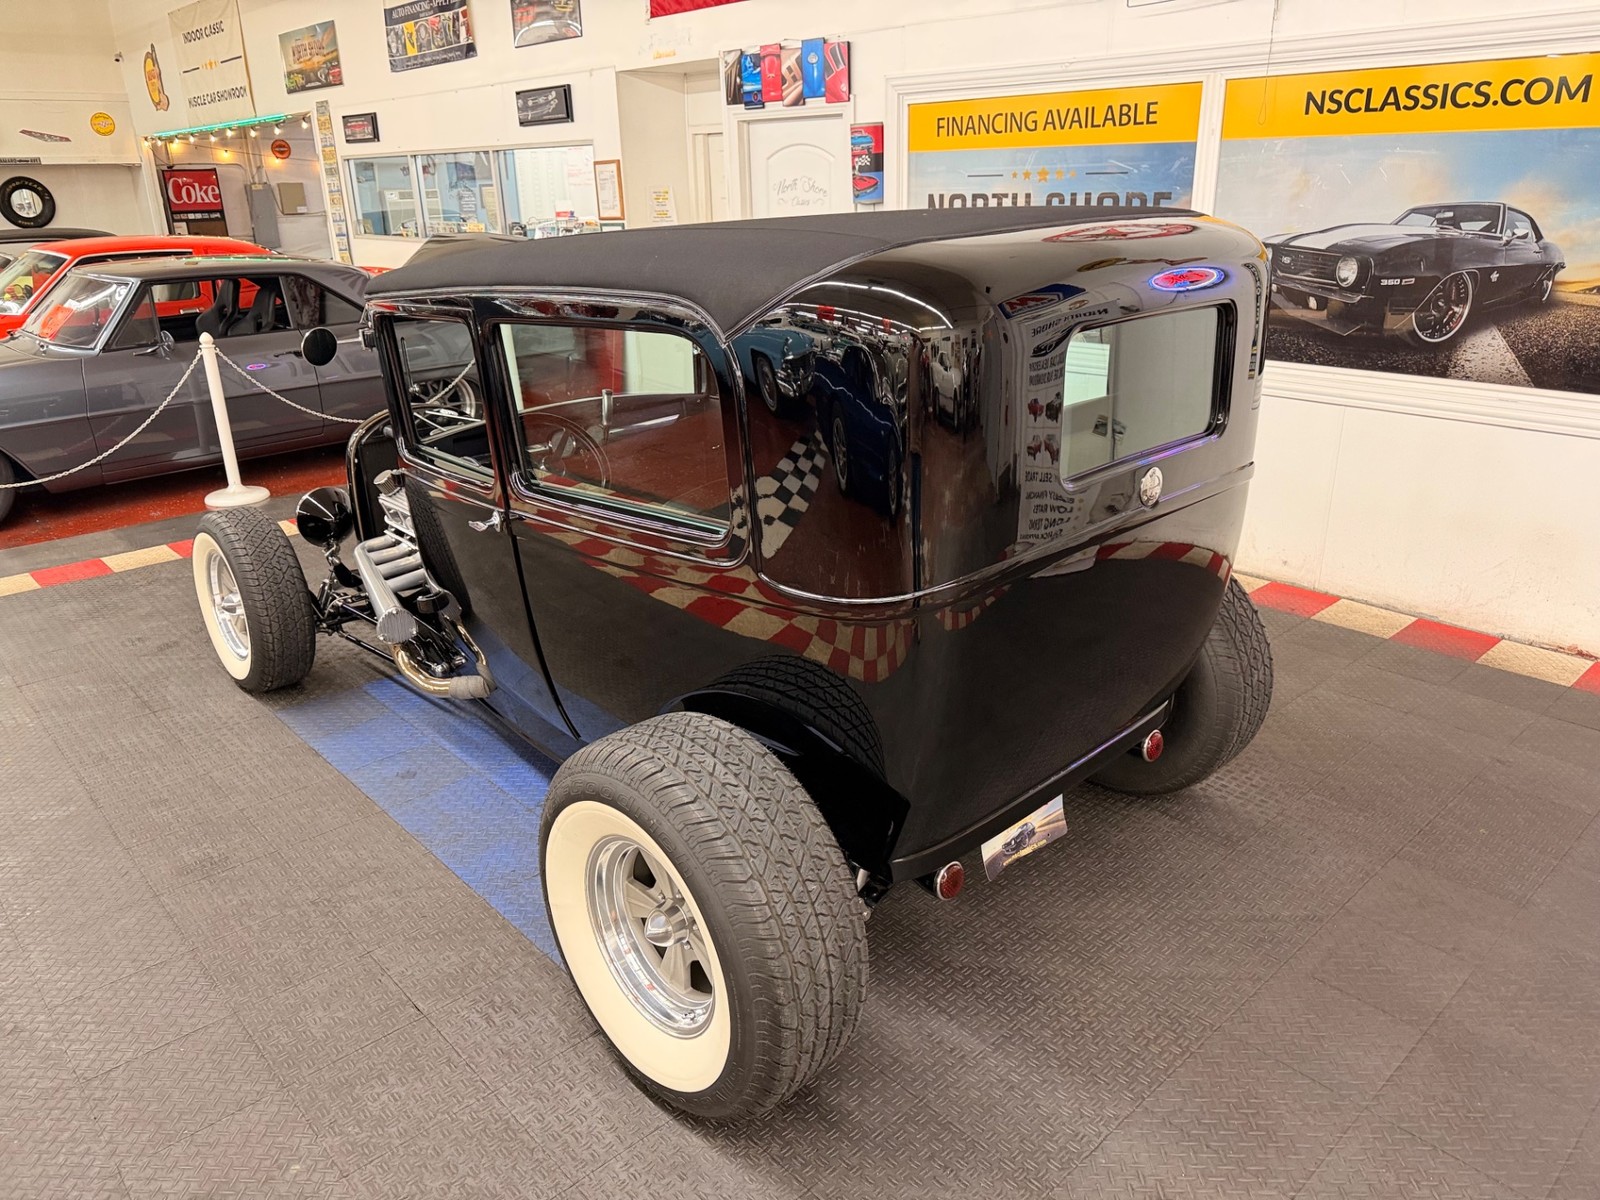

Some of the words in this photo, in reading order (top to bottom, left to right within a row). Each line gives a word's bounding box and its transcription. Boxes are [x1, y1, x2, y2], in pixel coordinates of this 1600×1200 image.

[182, 28, 204, 44] INDOOR
[204, 20, 225, 38] CLASSIC
[187, 94, 207, 109] MUSCLE
[206, 92, 217, 105] CAR
[216, 85, 248, 103] SHOWROOM
[1304, 74, 1593, 116] NSCLASSICS.COM
[936, 110, 1038, 138] FINANCING
[1043, 101, 1159, 132] AVAILABLE
[168, 177, 221, 204] Coke
[800, 176, 829, 197] Shore
[1380, 278, 1401, 286] 350
